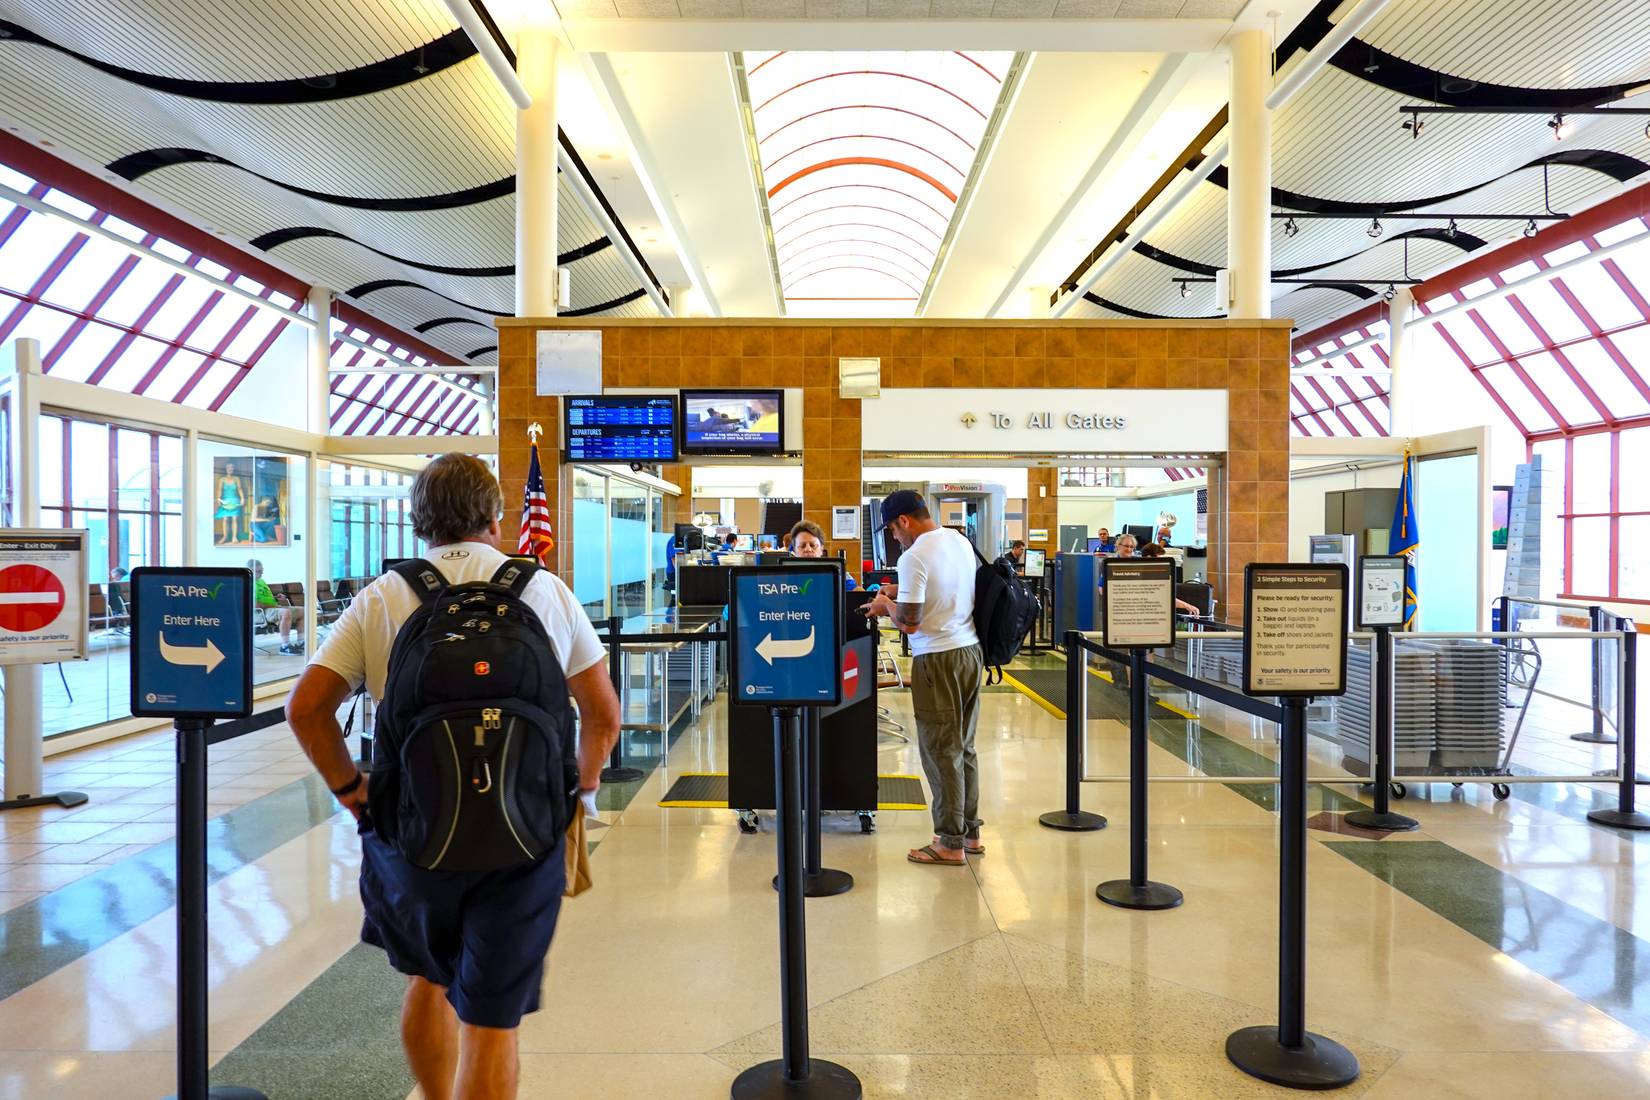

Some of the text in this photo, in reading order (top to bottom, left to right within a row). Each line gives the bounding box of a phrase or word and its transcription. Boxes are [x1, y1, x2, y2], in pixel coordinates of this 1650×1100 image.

[990, 412, 1126, 430] To All Gates
[163, 585, 208, 597] TSA Pre
[758, 584, 798, 594] TSA Pre
[163, 615, 220, 626] Enter Here
[760, 611, 811, 621] Enter Here
